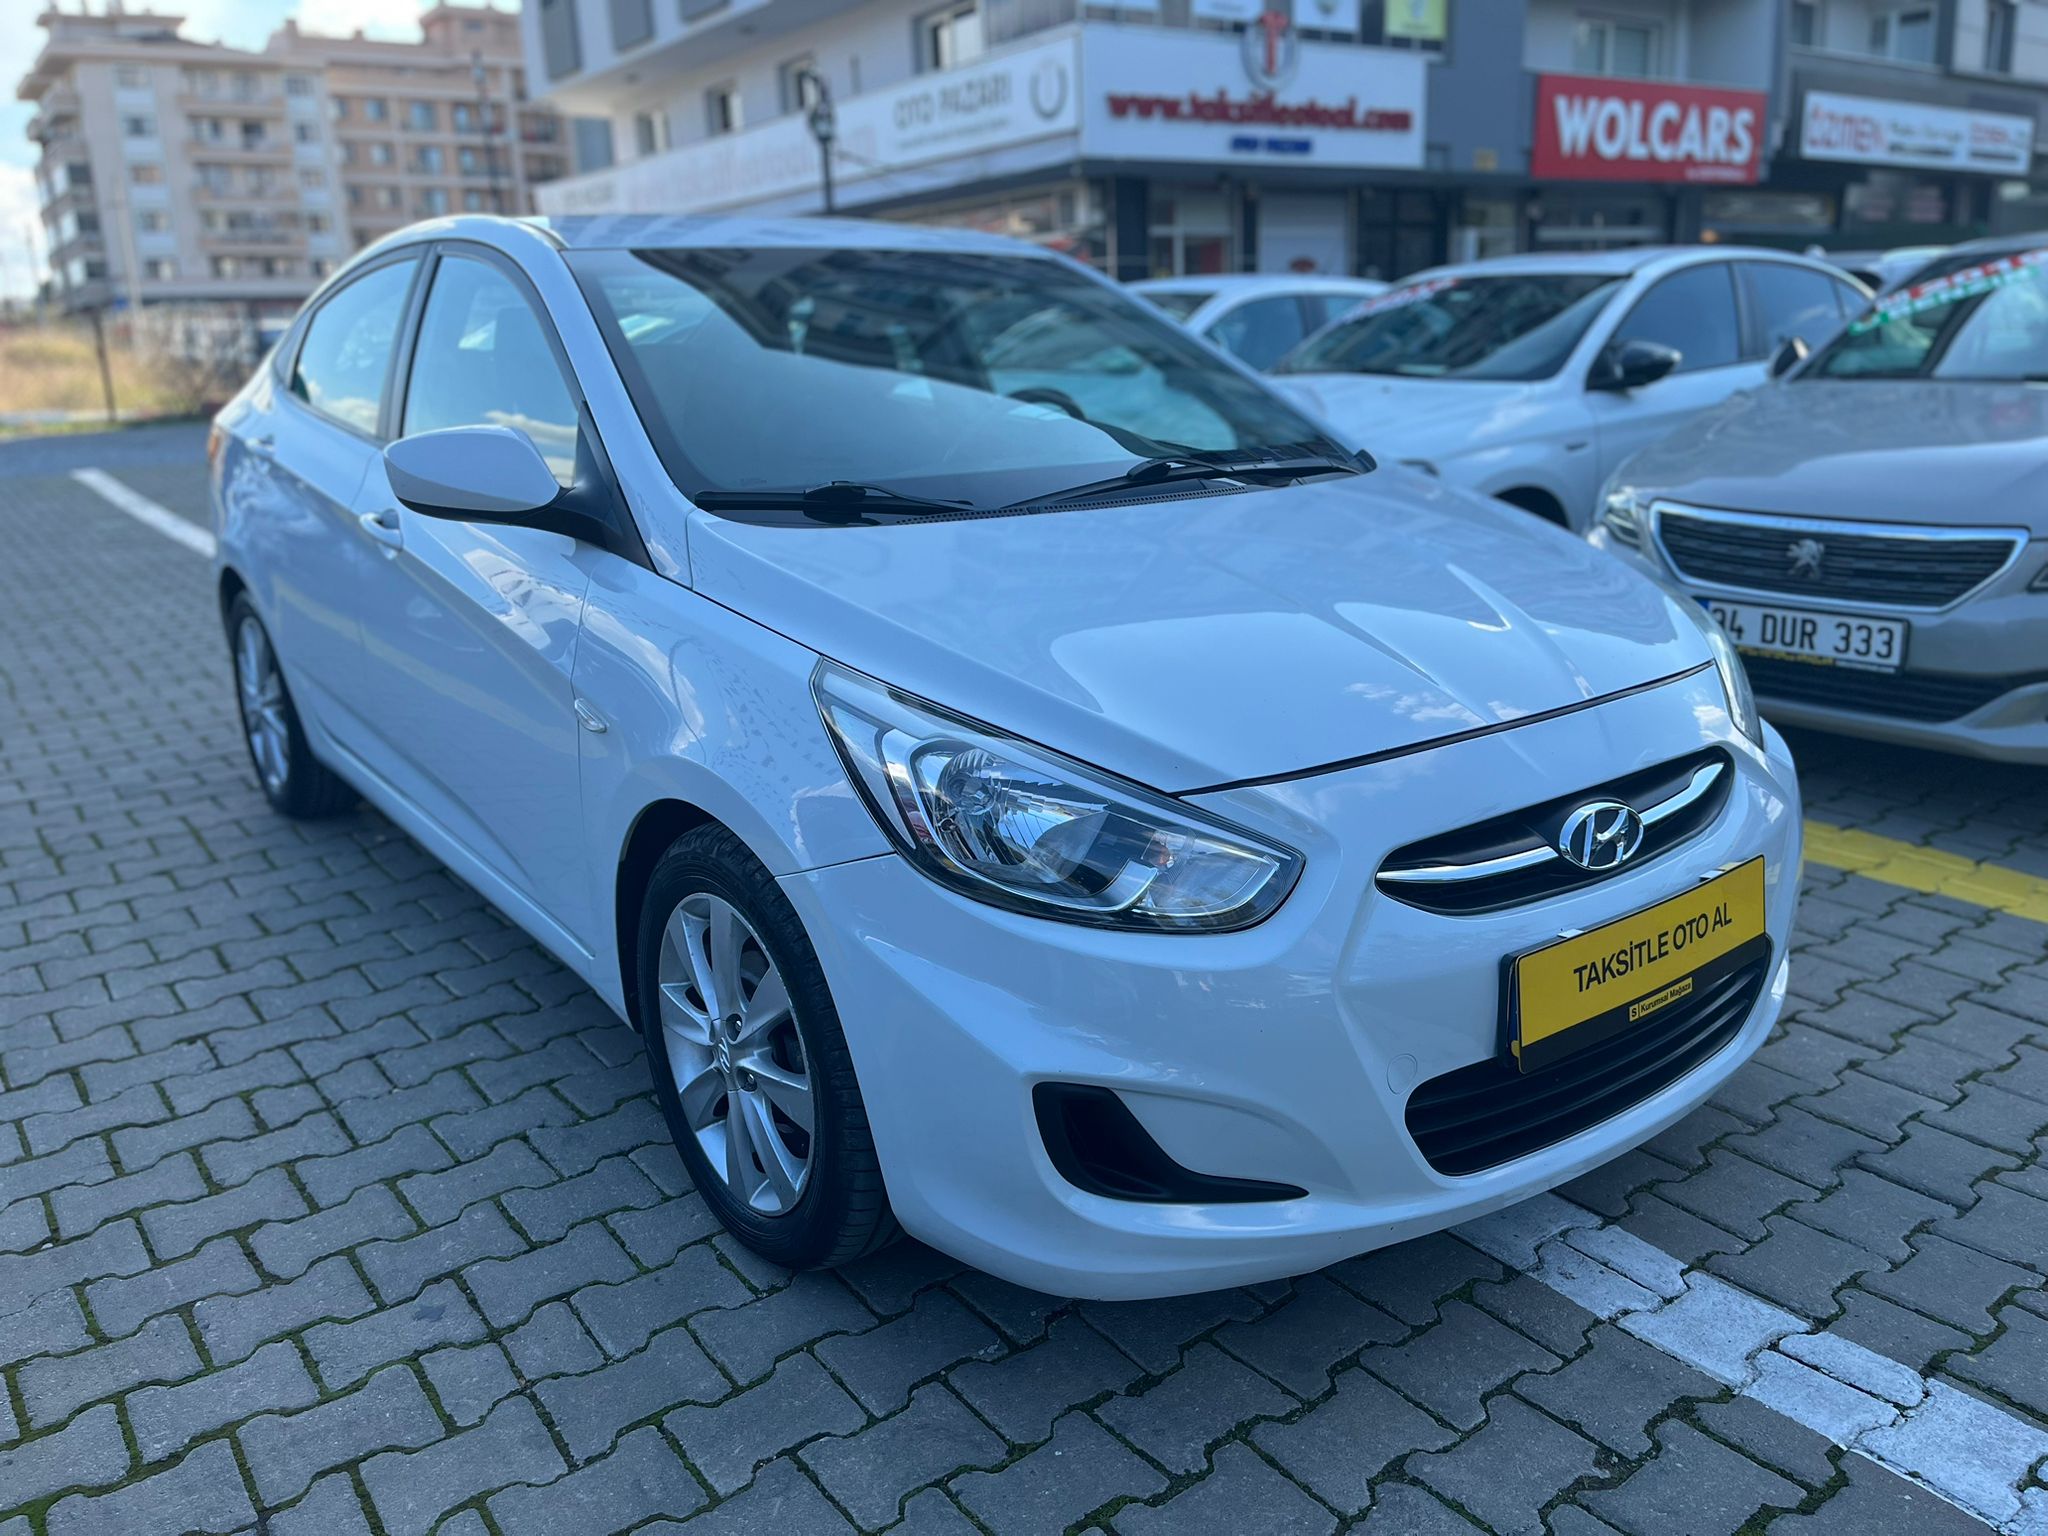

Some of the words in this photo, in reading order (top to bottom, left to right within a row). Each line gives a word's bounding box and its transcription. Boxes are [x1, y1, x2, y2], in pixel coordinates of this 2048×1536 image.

[1553, 94, 1754, 164] WOLCARS
[1761, 613, 1817, 650] DUR
[1833, 622, 1894, 659] 333
[1573, 931, 1669, 992] TAKSİTLE
[1673, 913, 1709, 950] OTO
[1712, 902, 1732, 932] AL
[1640, 991, 1669, 1013] Kurumsal
